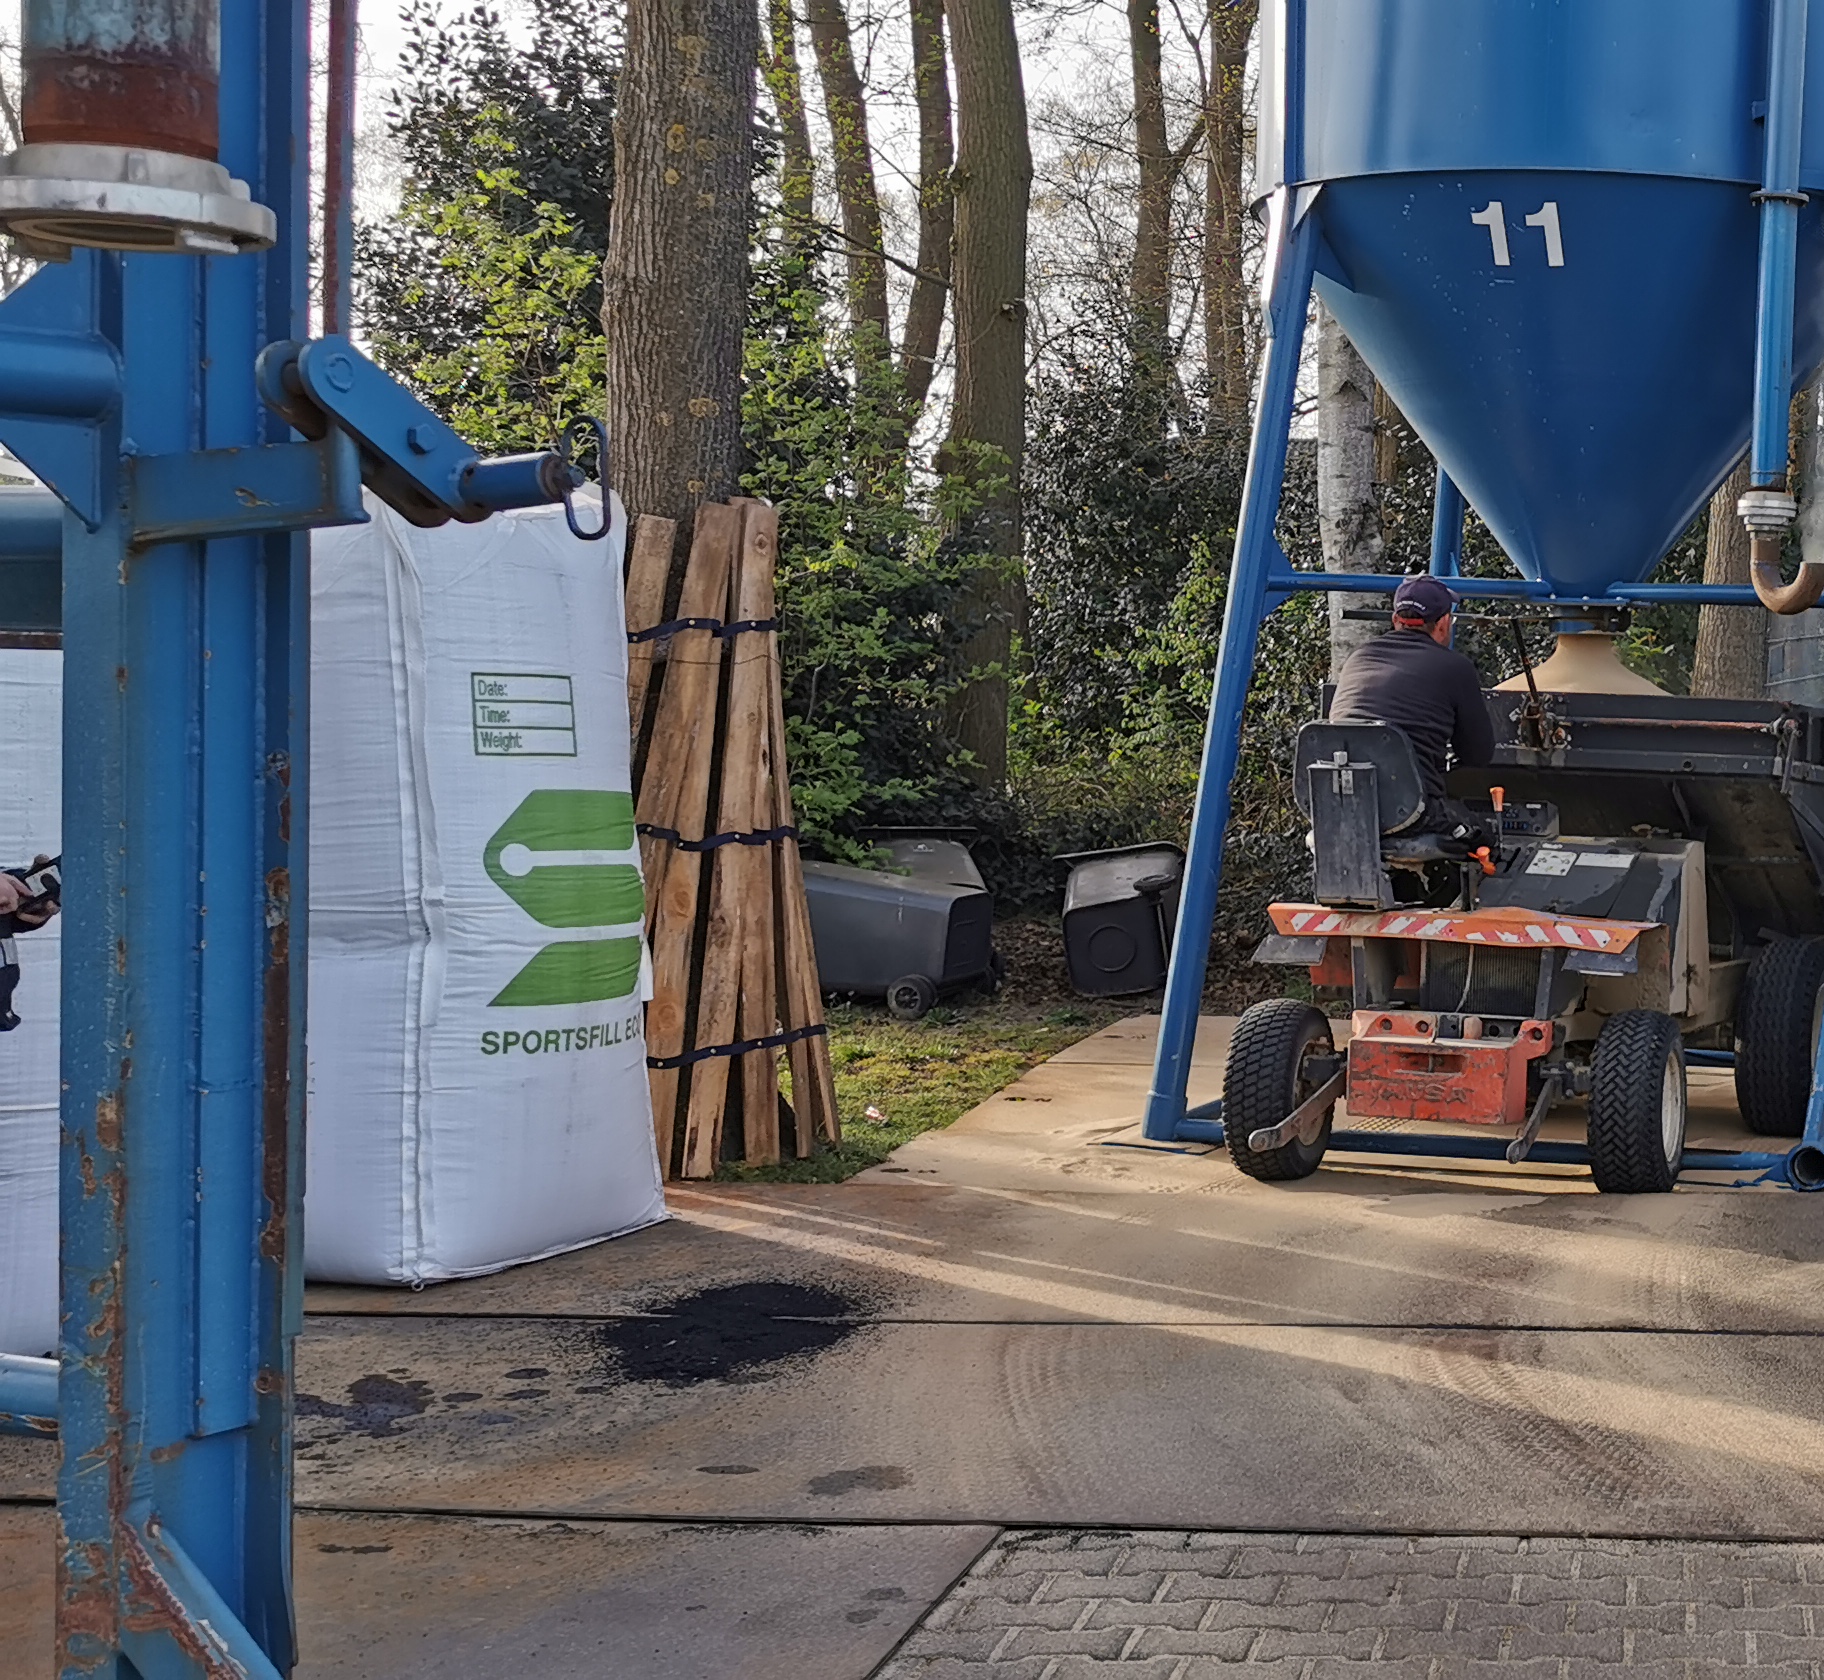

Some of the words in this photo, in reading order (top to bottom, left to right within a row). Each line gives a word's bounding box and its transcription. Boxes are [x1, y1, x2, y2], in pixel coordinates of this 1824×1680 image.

[1471, 201, 1565, 267] 11
[477, 679, 508, 697] Date:
[479, 705, 511, 723] Time:
[480, 731, 523, 752] Weight:
[480, 1021, 622, 1056] SPORTSFILL
